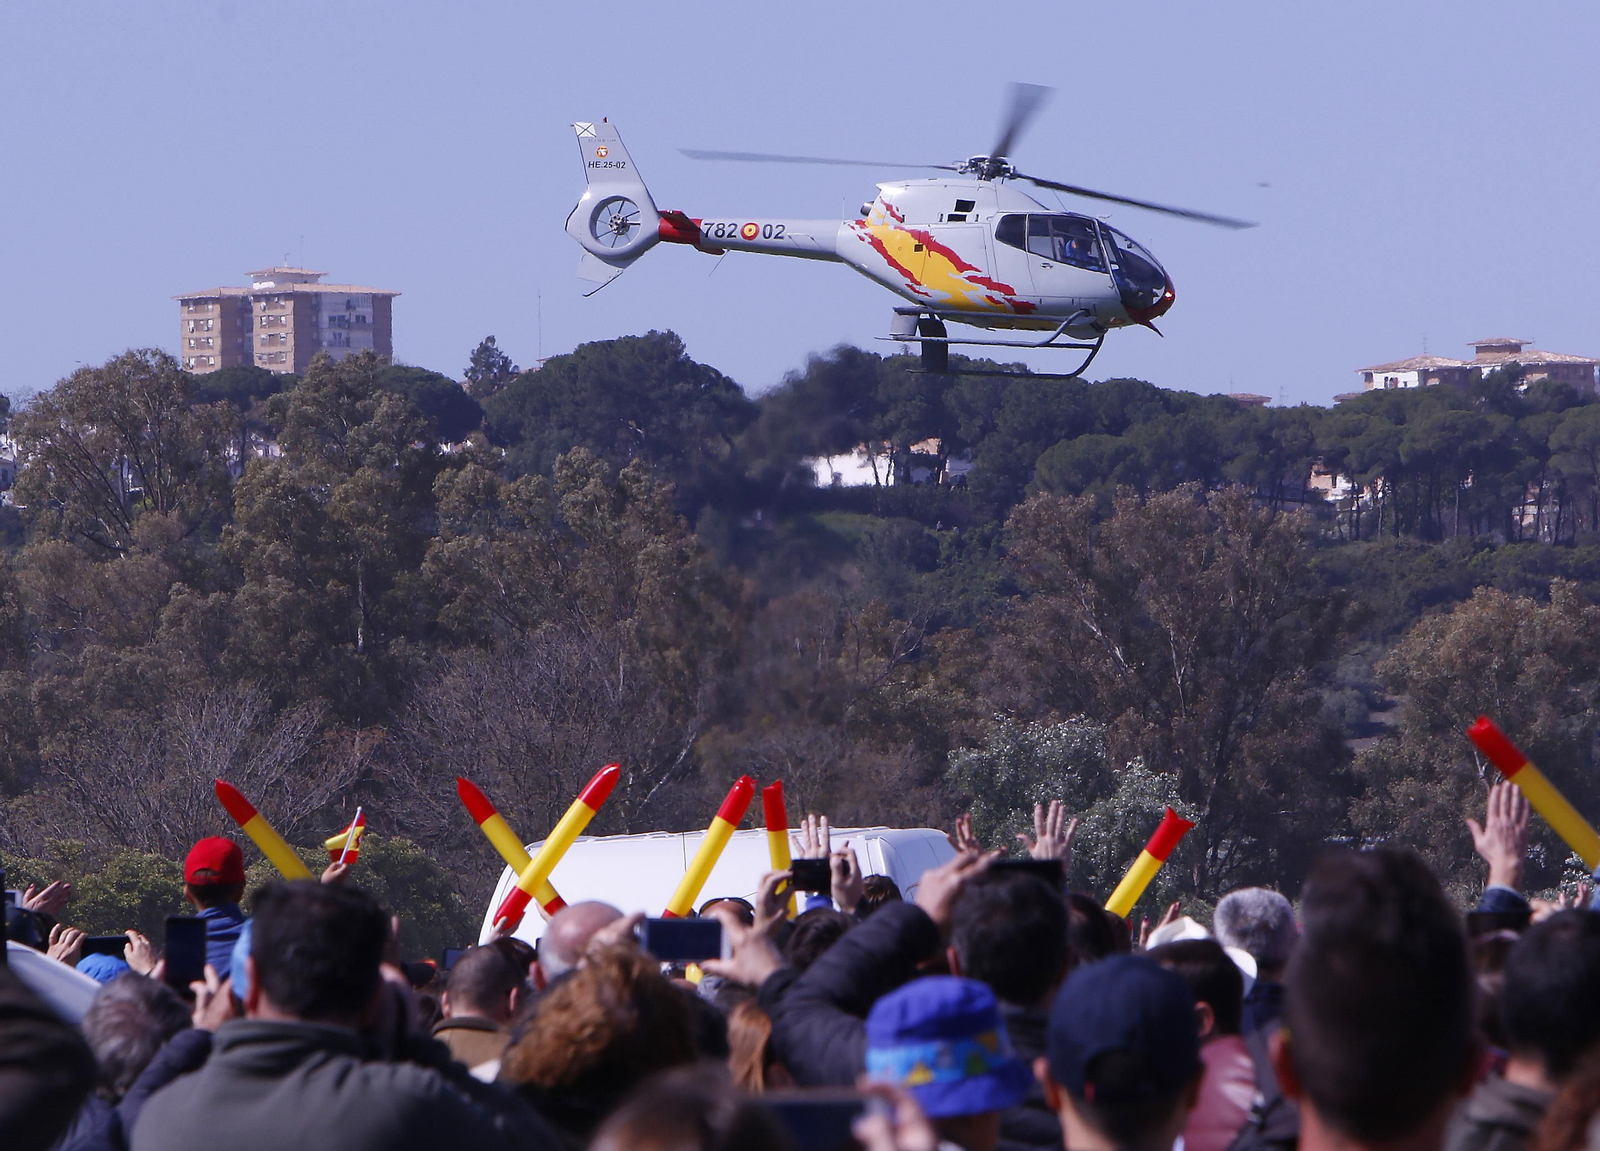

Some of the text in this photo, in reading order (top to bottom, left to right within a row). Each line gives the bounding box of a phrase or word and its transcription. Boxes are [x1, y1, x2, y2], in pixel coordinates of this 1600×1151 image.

[588, 161, 626, 169] HE.25-02
[703, 222, 786, 240] 782 02
